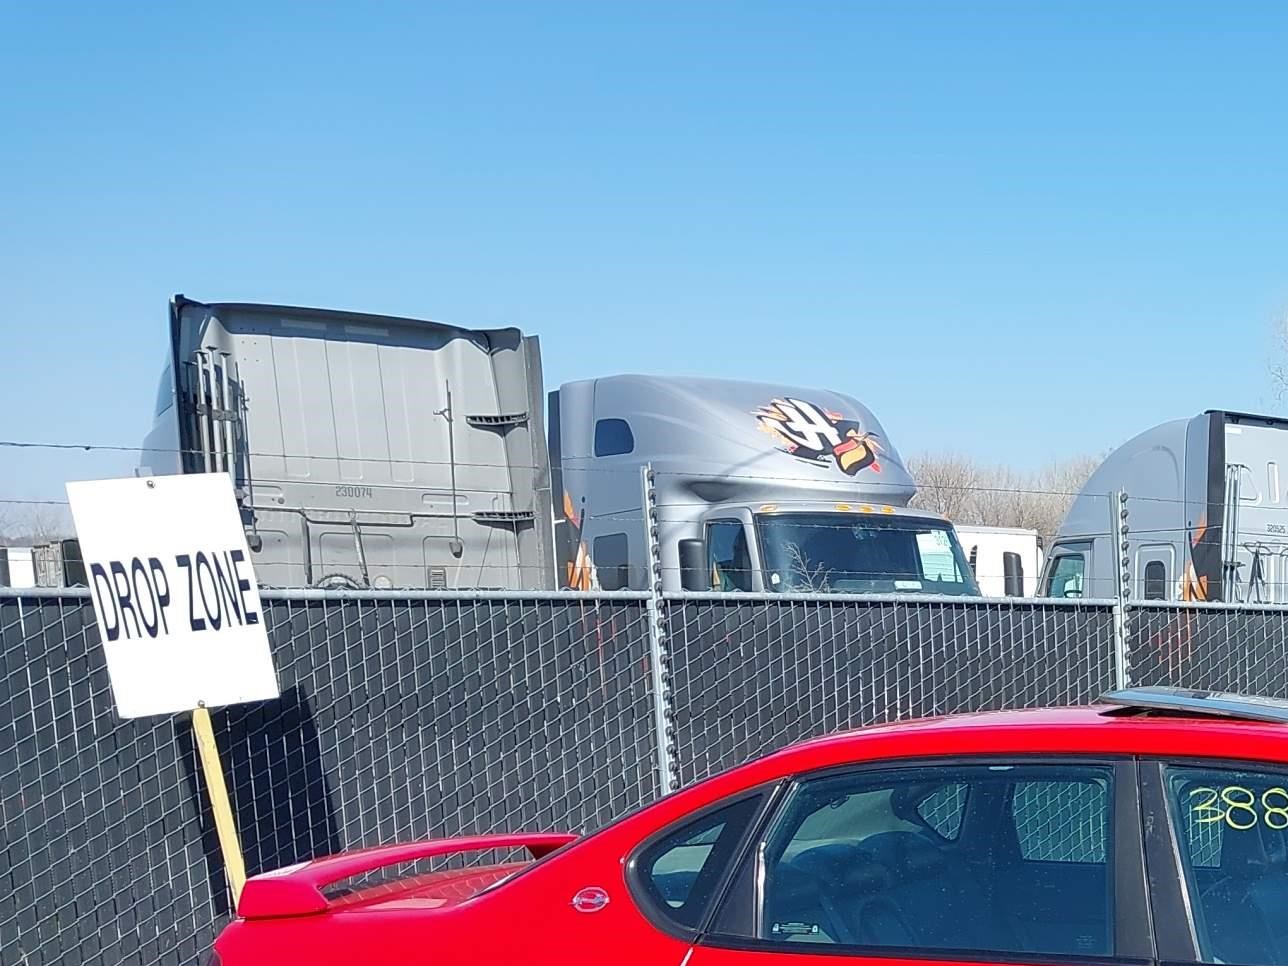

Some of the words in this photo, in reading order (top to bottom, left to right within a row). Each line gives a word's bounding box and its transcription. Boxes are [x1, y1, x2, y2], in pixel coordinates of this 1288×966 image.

[336, 486, 373, 498] 230074
[90, 556, 171, 642] DROP
[175, 549, 259, 632] ZONE
